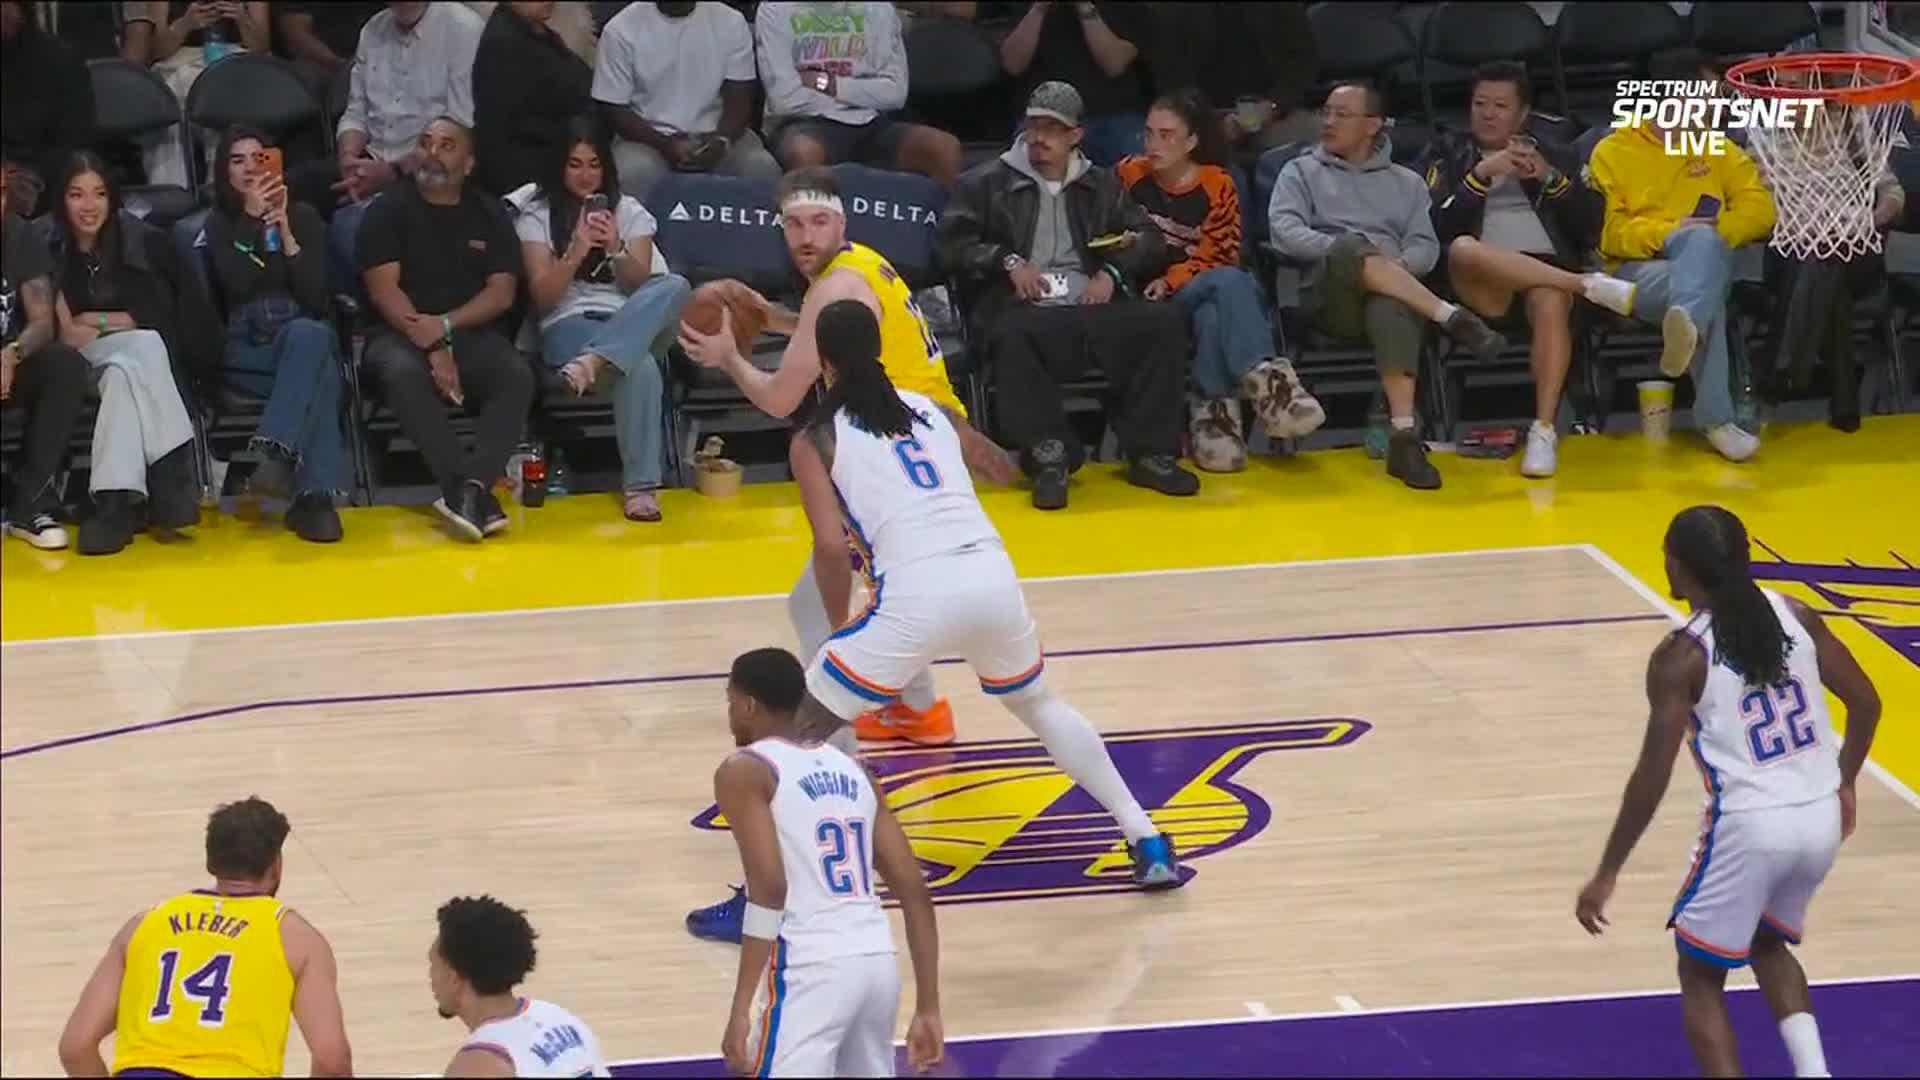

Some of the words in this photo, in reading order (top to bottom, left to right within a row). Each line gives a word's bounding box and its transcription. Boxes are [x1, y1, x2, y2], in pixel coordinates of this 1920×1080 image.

[699, 204, 785, 229] DELTA
[852, 196, 938, 226] DELTA
[893, 438, 942, 491] 6
[1739, 676, 1819, 765] 22
[797, 770, 858, 802] WIGGINS
[815, 818, 871, 897] 21
[168, 911, 249, 938] KLEBER
[150, 949, 234, 1025] 14
